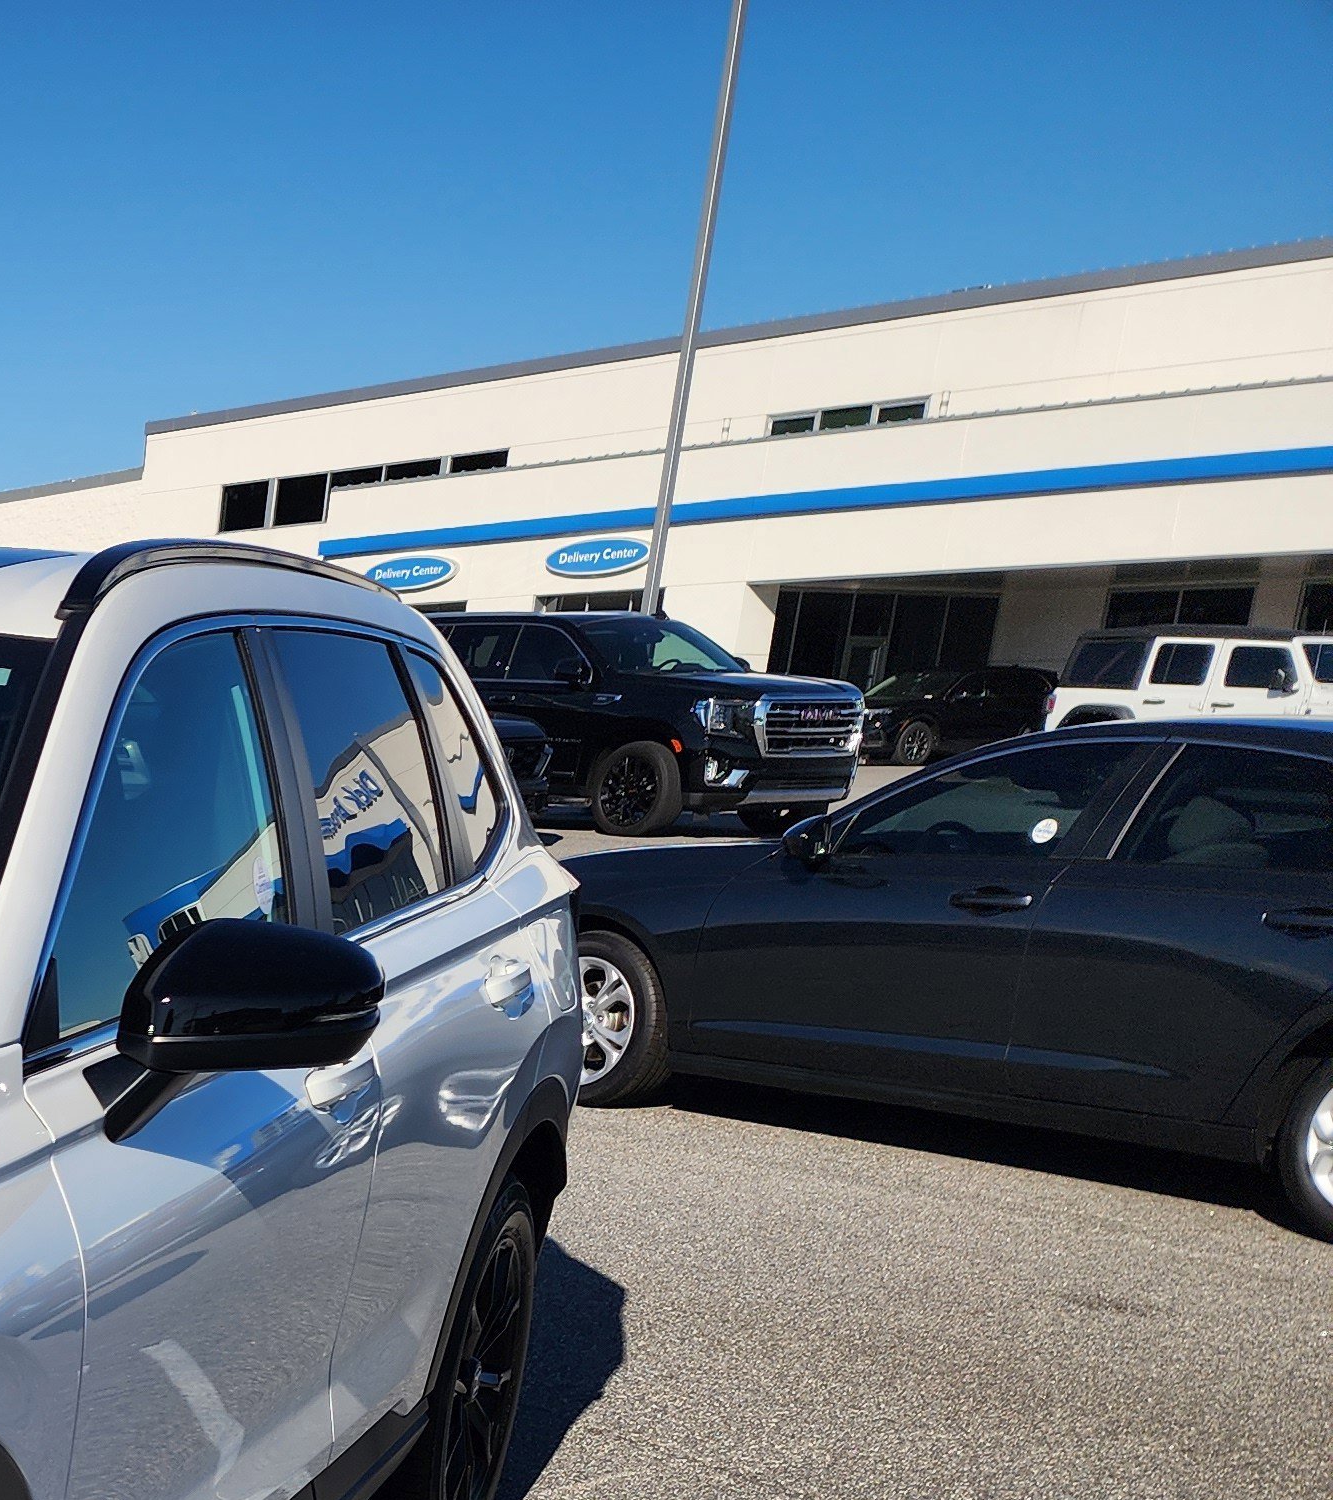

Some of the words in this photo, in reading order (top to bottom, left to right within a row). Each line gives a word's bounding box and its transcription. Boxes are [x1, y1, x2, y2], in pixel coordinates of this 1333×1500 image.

[558, 551, 601, 565] Delivery
[602, 548, 639, 560] Center
[374, 568, 411, 581] Delivery
[412, 565, 444, 577] Center
